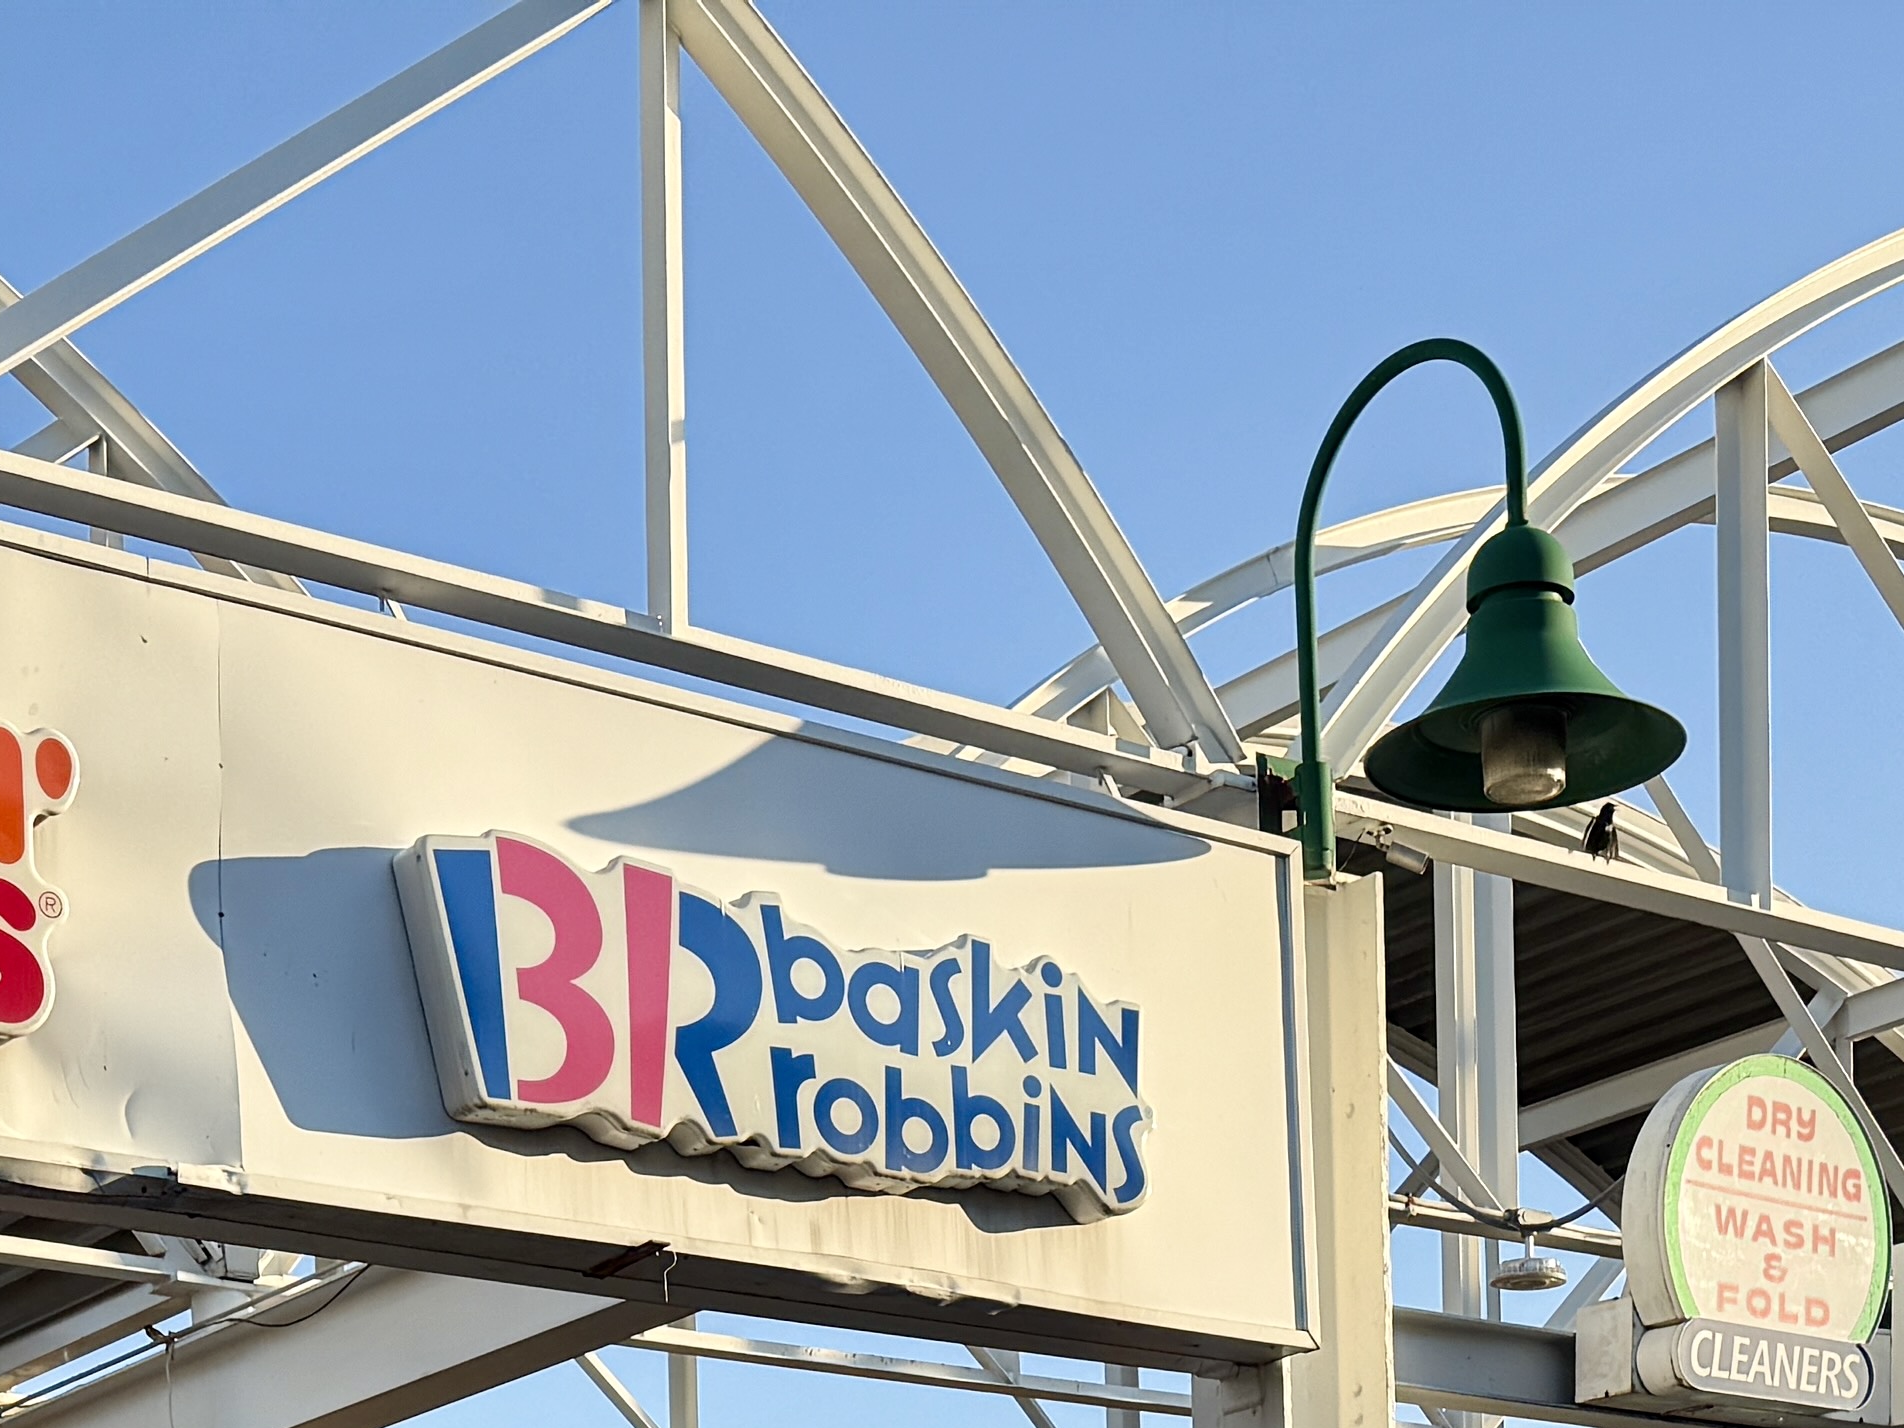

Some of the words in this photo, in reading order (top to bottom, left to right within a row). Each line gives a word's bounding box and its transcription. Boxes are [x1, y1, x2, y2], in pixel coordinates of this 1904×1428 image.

[1745, 1094, 1817, 1142] DRY
[1695, 1139, 1863, 1204] CLEANING
[1714, 1203, 1837, 1258] WASH
[1762, 1252, 1789, 1284] &
[1715, 1281, 1831, 1328] FOLD
[1689, 1328, 1861, 1400] CLEANERS
